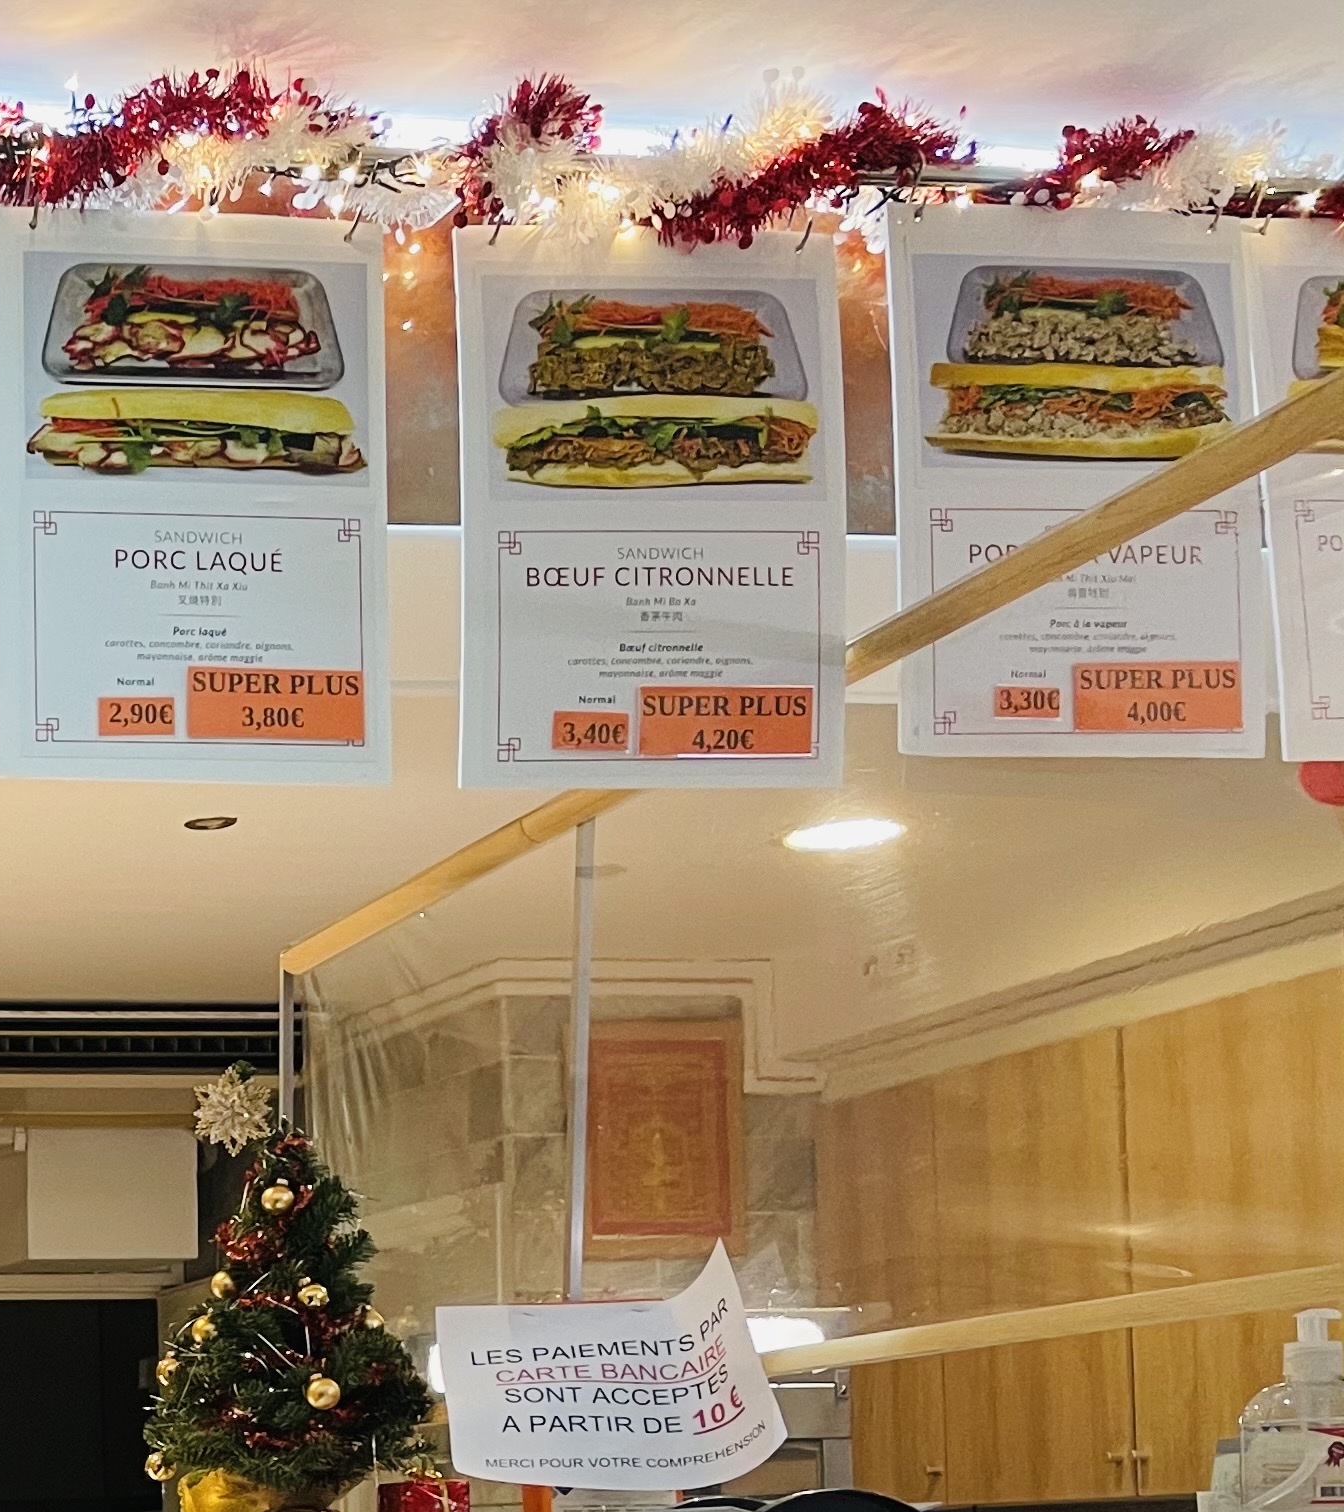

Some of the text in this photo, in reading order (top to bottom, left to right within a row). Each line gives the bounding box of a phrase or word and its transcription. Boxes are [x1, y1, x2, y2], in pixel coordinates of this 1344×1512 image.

[154, 530, 242, 545] SANDWICH
[115, 548, 282, 575] PORC LAQUÉ
[617, 547, 704, 560] SANDWICH
[970, 544, 1018, 563] PO
[1109, 545, 1203, 565] VAPEUR
[527, 567, 793, 587] BŒUF CITRONNELLE
[173, 626, 227, 639] Porc laqué
[649, 642, 703, 652] citronnelle
[117, 676, 154, 686] Normal
[192, 672, 359, 696] SUPER PLUS
[1011, 670, 1046, 679] Normal
[1081, 669, 1236, 689] SUPER PLUS
[579, 695, 616, 705] Normal
[643, 695, 806, 717] SUPER PLUS
[1000, 689, 1060, 712] 3,30€
[109, 703, 172, 727] 2,90€
[241, 707, 304, 730] 3,80€
[1128, 702, 1186, 724] 4,00€
[563, 722, 626, 746] 3,40€
[692, 729, 754, 752] 4,20€
[471, 1298, 728, 1366] LES PAIEMENTS PAR
[496, 1334, 727, 1383] CARTE BANCAIRE
[505, 1364, 729, 1406] SONT ACCEPTES
[502, 1416, 520, 1433] A
[531, 1415, 634, 1433] PARTIR
[645, 1416, 683, 1434] DE
[693, 1402, 726, 1430] 10
[485, 1420, 767, 1469] MERCI POUR VOTRE COMPREHENSION
